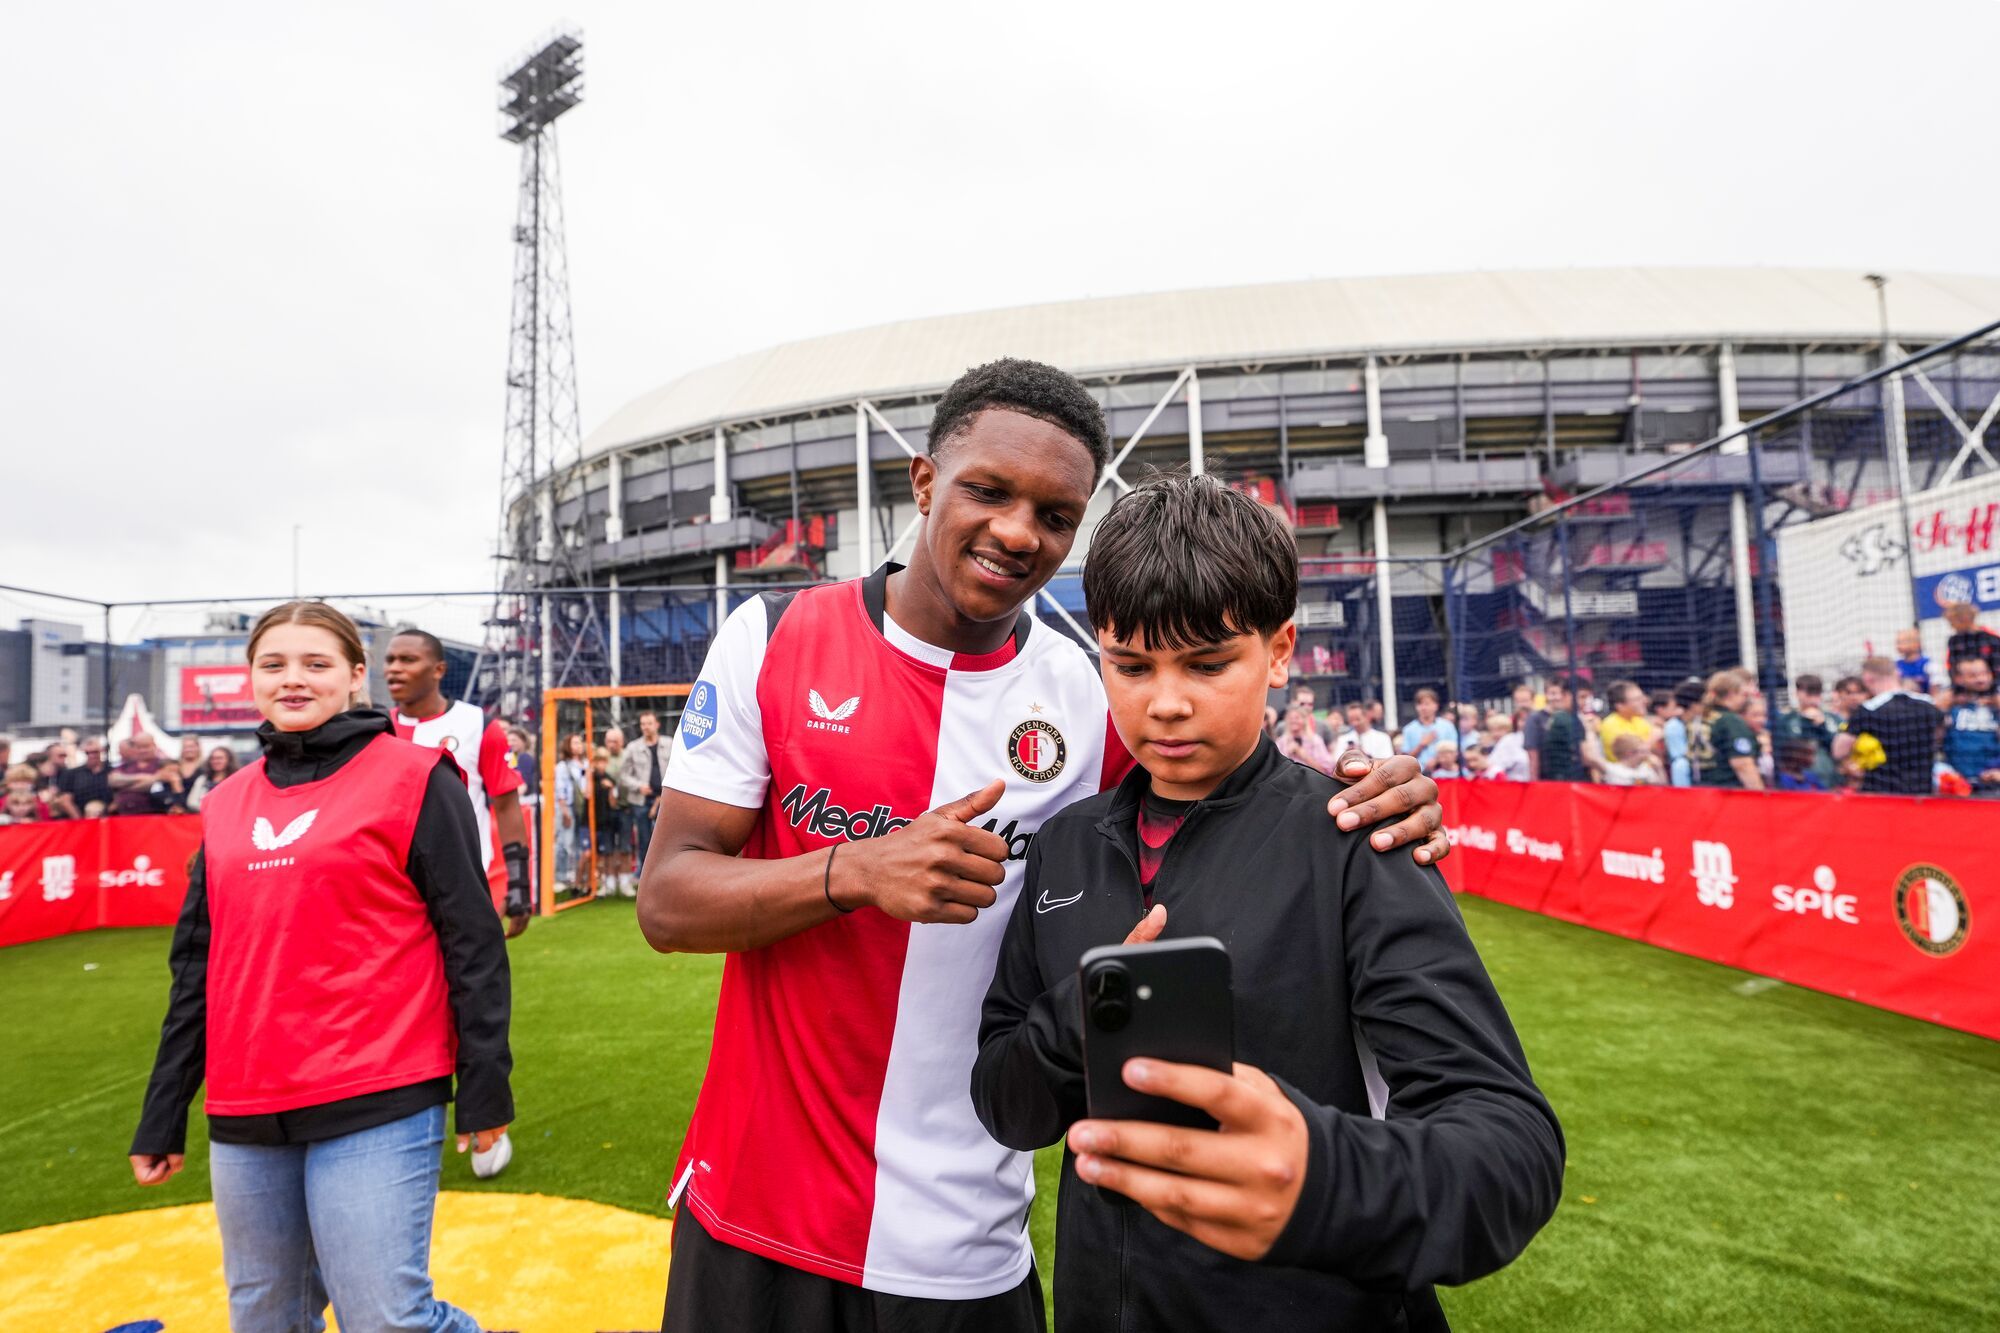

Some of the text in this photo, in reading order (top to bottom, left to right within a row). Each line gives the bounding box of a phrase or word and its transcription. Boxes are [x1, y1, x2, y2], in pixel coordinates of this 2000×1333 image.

[806, 719, 851, 734] CASTORE
[1011, 720, 1063, 745] FEYENOORD
[1010, 756, 1064, 781] ROTTERDAM
